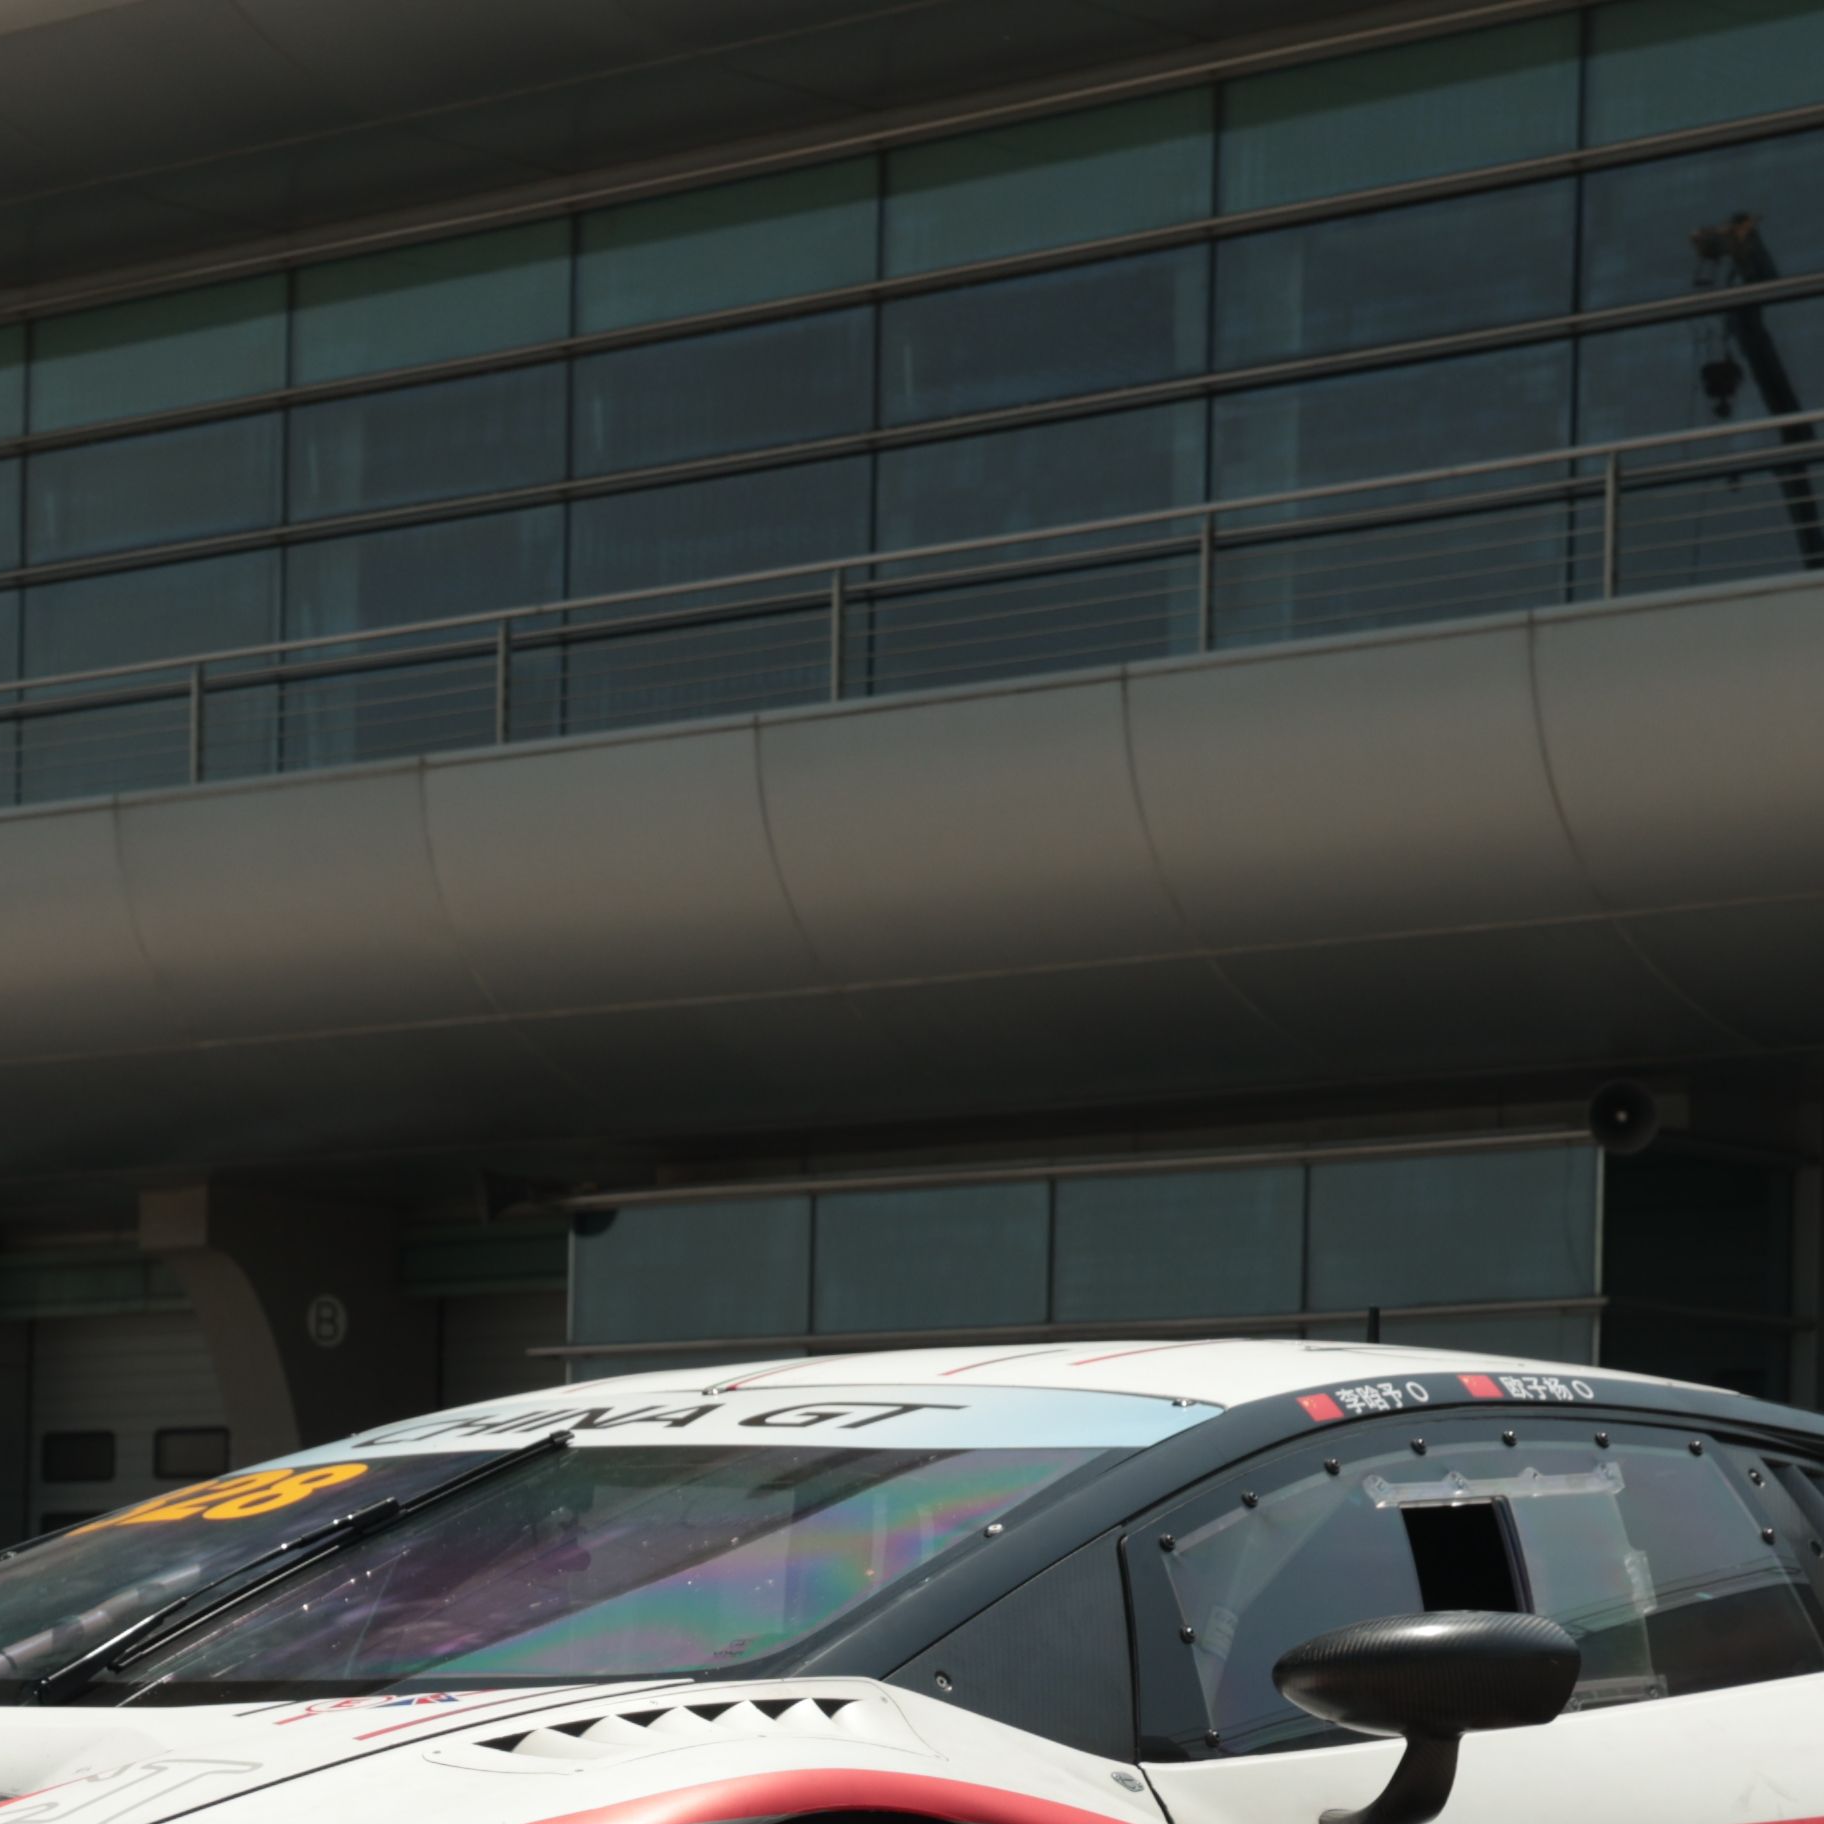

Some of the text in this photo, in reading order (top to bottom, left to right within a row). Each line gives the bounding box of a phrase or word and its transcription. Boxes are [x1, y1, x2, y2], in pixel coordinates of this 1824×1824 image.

[316, 1301, 339, 1341] B
[353, 1401, 971, 1450] CHINA GT
